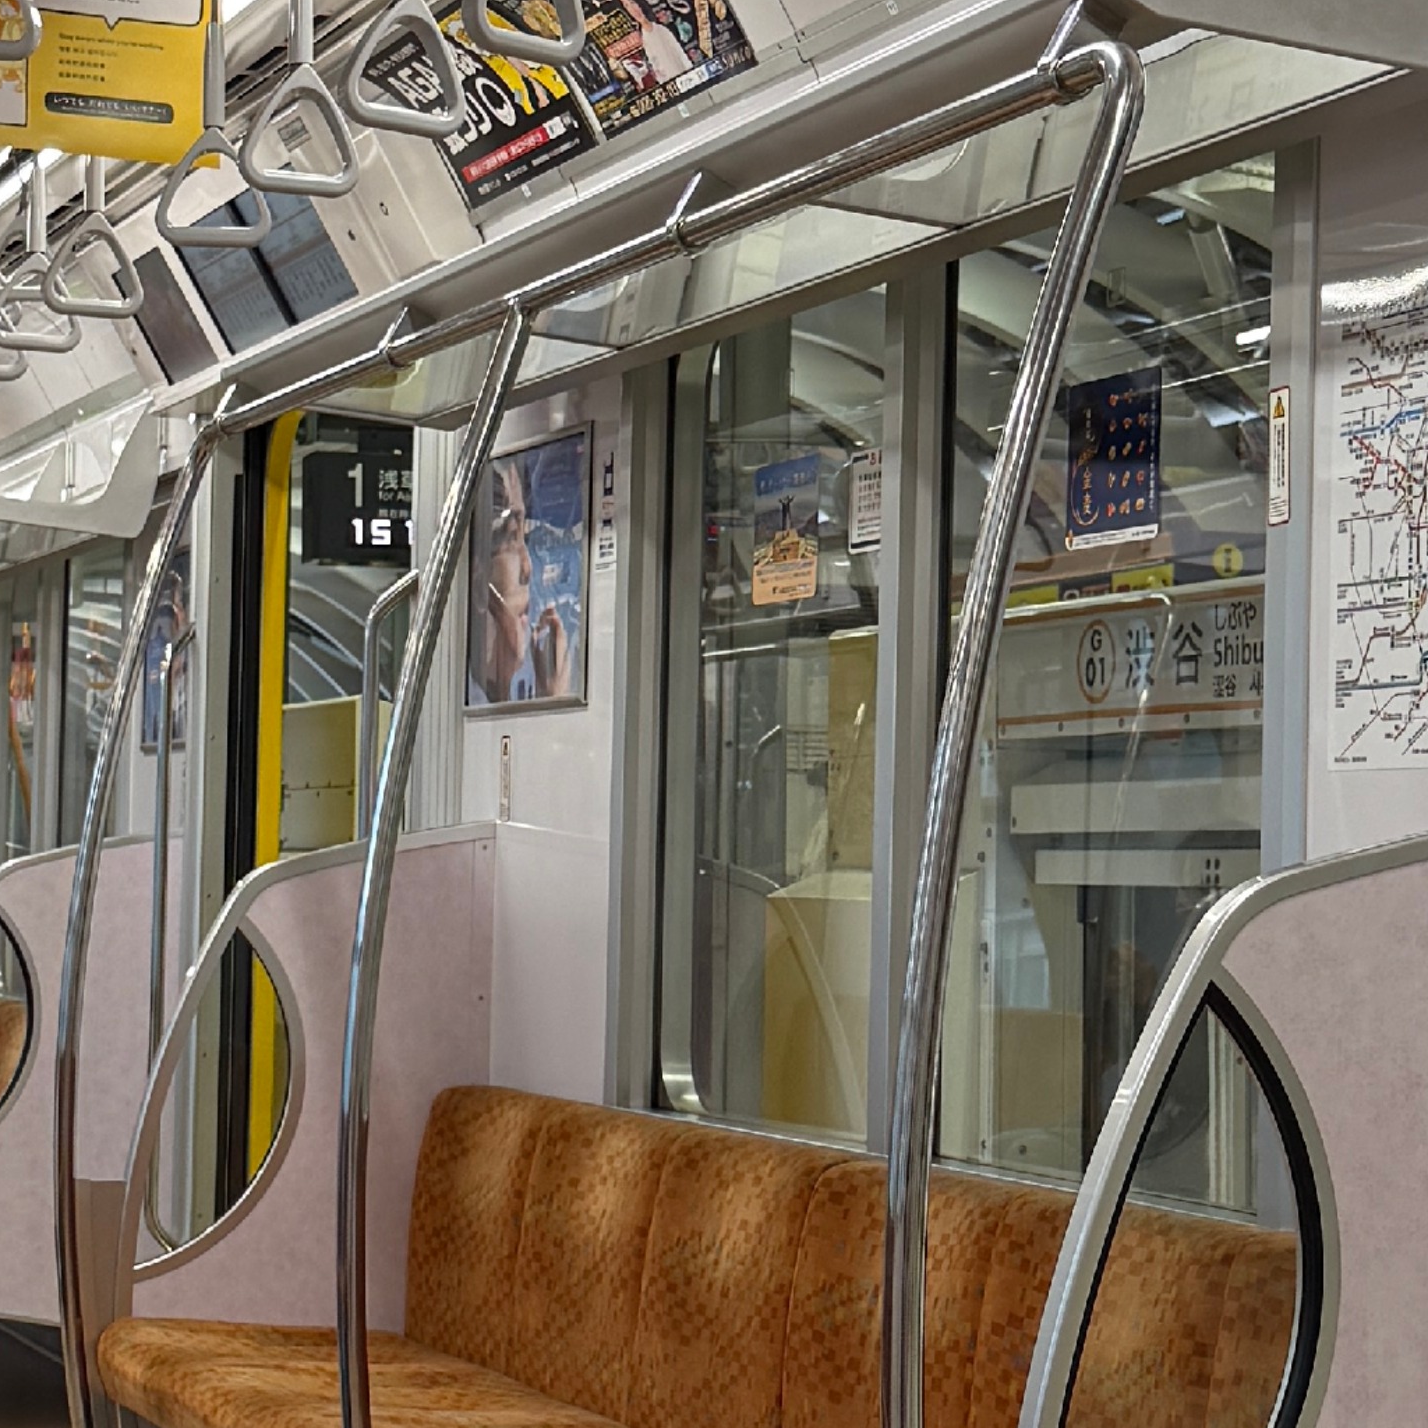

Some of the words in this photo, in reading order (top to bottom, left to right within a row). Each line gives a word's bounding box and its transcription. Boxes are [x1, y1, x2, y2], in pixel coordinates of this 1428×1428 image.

[347, 462, 364, 509] 1
[351, 517, 392, 546] 15
[1090, 629, 1103, 652] G
[1125, 620, 1204, 689] 渋谷
[1213, 601, 1257, 632] しぶや
[1084, 657, 1106, 687] 01
